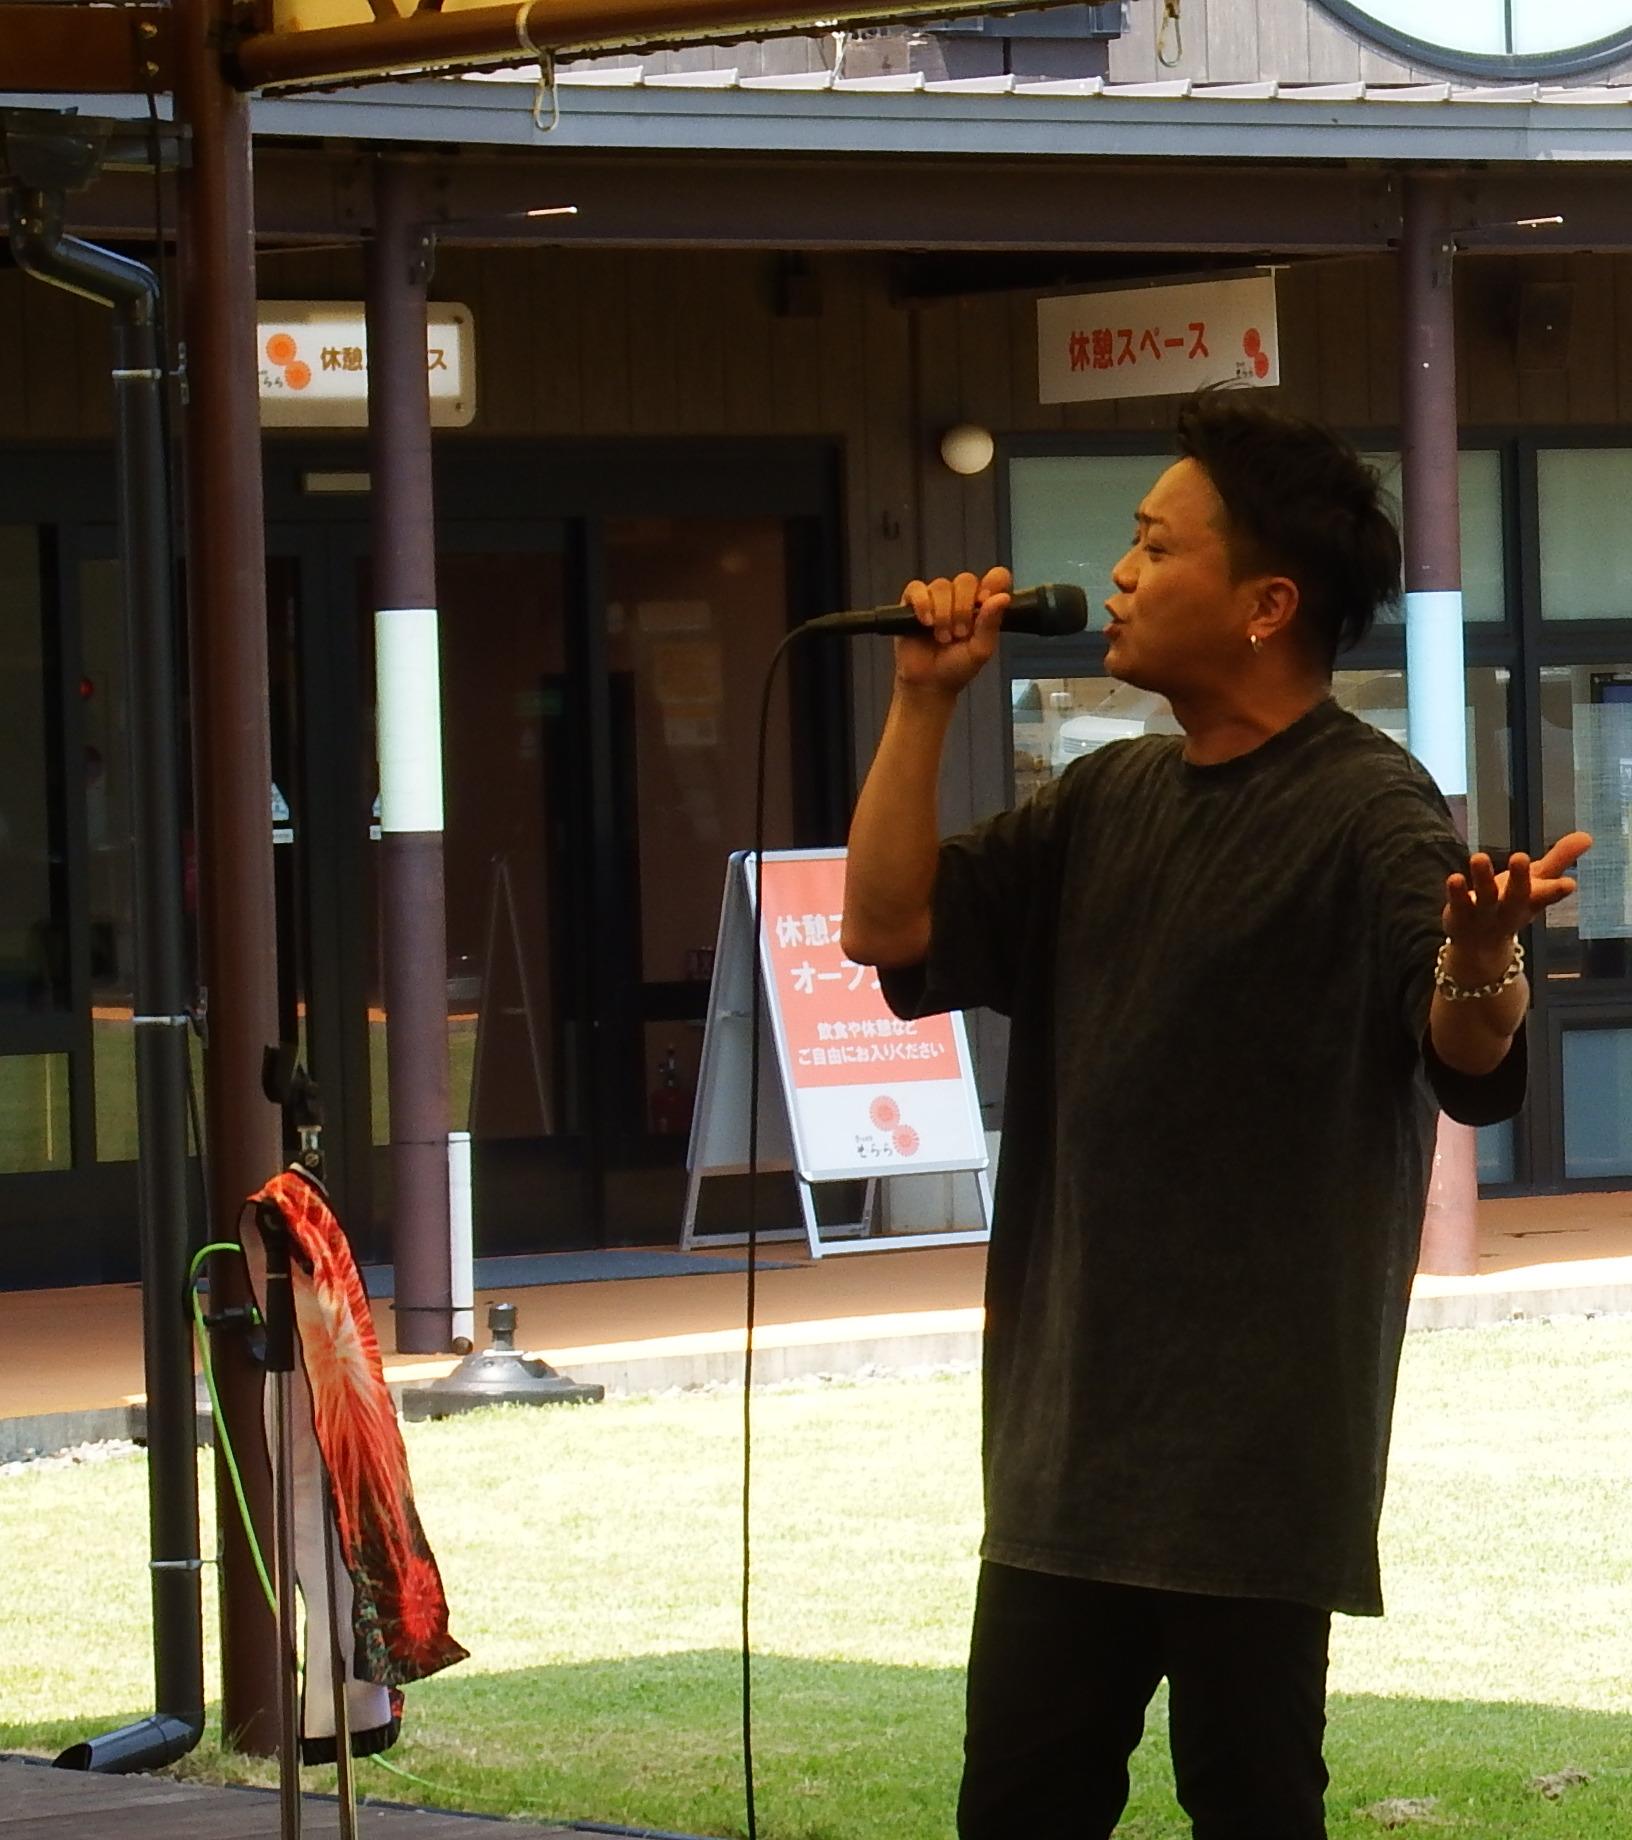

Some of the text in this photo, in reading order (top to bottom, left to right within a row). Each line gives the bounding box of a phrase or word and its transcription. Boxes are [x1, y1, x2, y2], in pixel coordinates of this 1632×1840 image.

[1069, 322, 1209, 371] 休憩スペース
[798, 1041, 945, 1066] ご自由にお入りください
